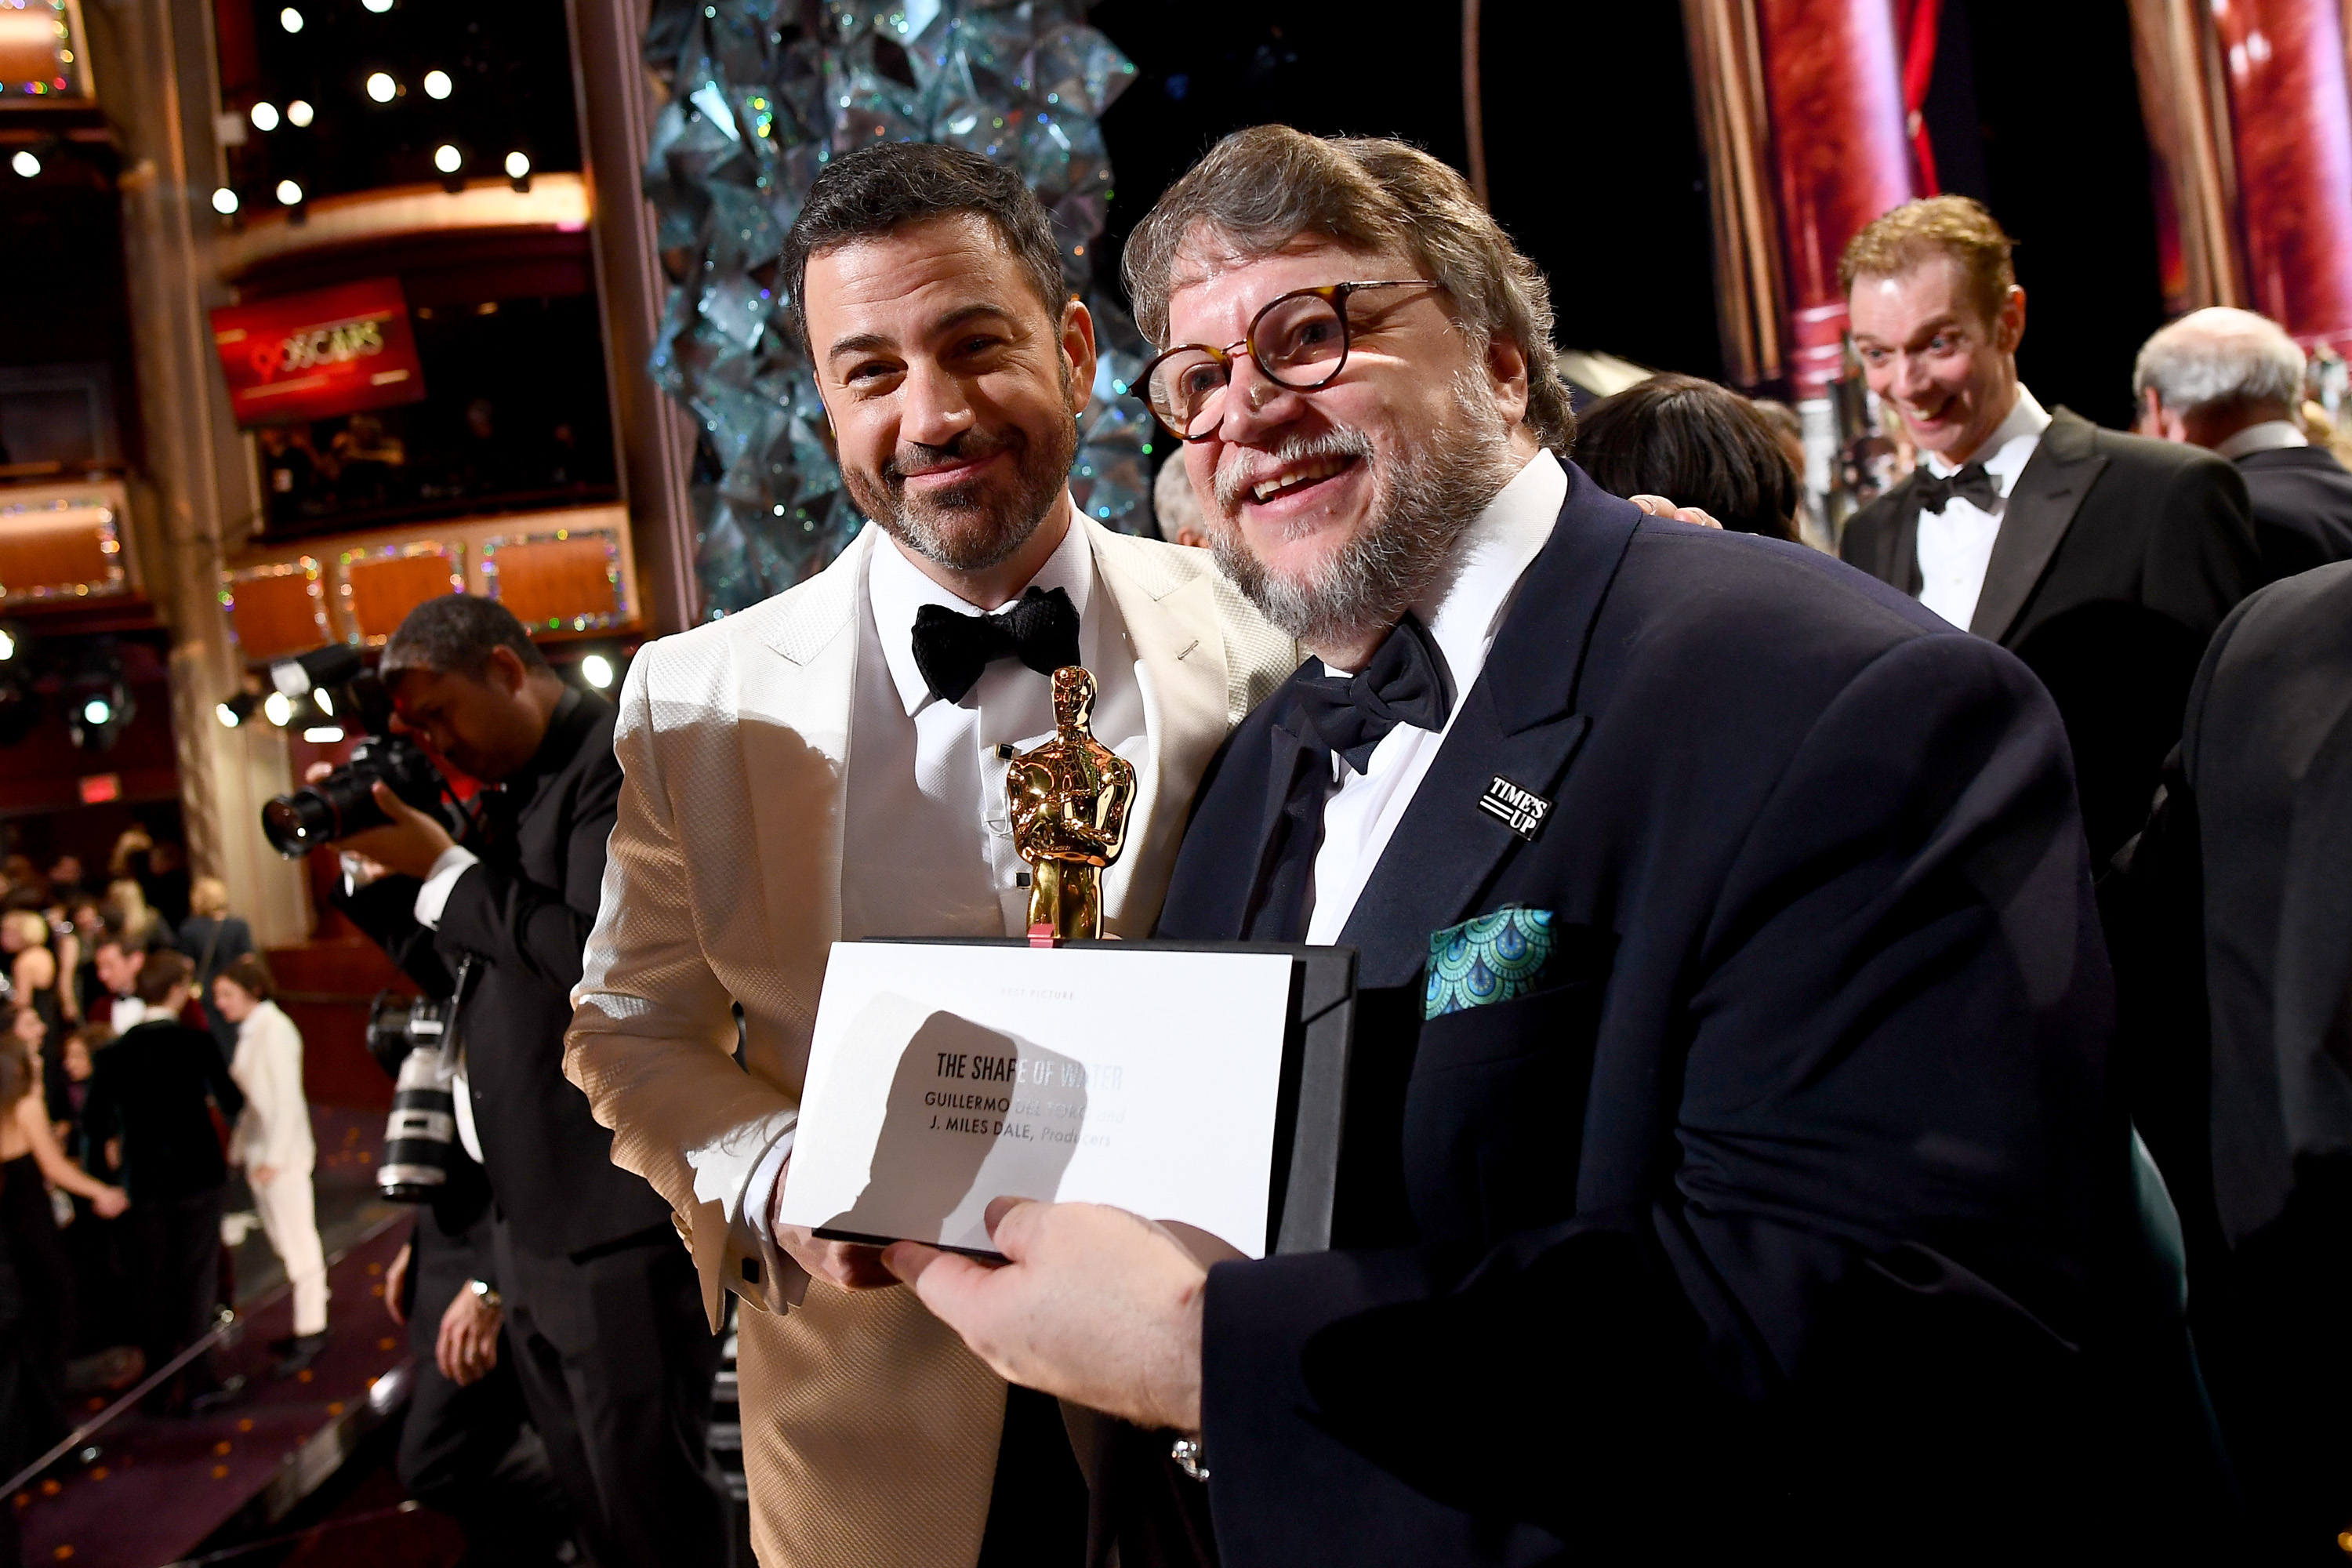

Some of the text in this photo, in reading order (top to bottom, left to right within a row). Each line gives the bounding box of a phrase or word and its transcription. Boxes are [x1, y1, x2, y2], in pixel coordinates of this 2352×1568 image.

[1490, 776, 1548, 819] TIME'S
[1509, 808, 1537, 833] UP
[1029, 989, 1076, 1000] PICTURE
[937, 1052, 967, 1079] THE
[971, 1055, 1029, 1083] SHAPE
[1033, 1060, 1055, 1087] OF
[925, 1091, 1010, 1112] GUILLERMO
[1098, 1106, 1127, 1123] and
[930, 1115, 1111, 1147] J. MILES DALE, Producers
